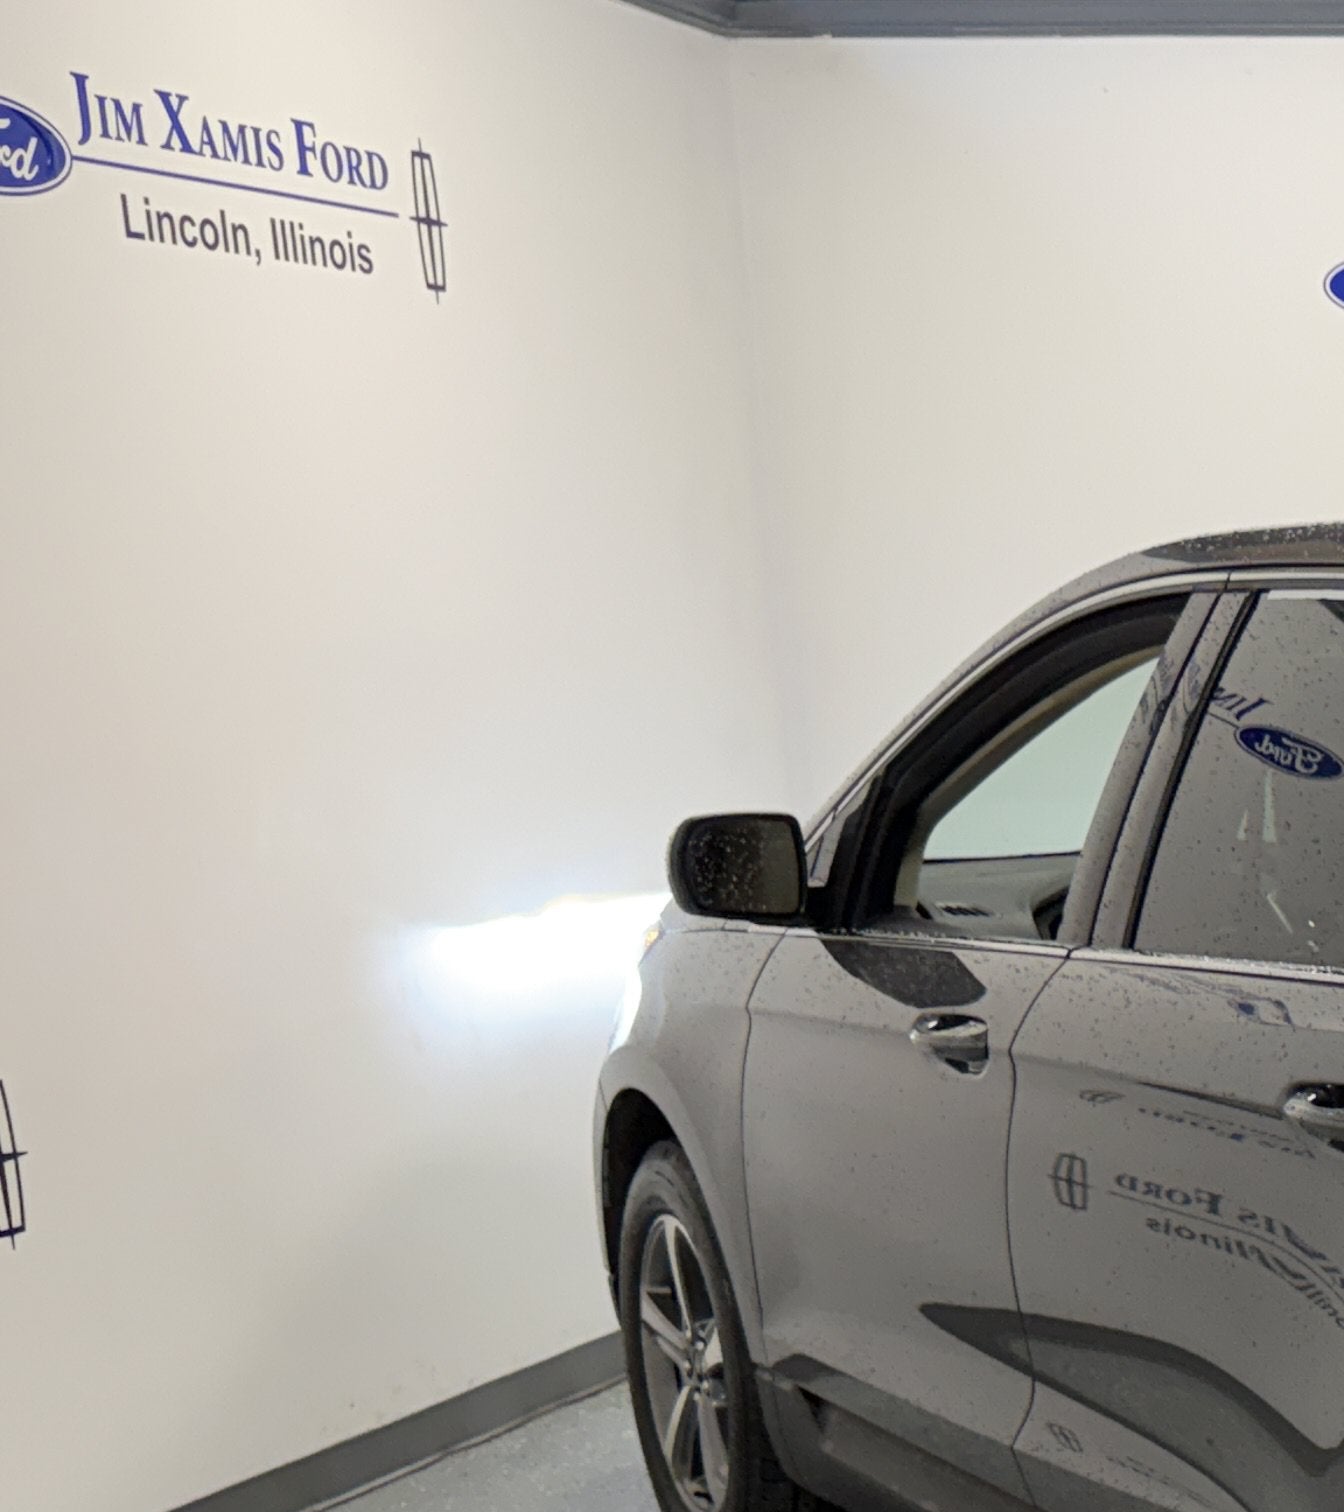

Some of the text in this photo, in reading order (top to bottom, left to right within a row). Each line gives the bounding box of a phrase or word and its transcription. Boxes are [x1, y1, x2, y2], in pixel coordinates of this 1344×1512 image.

[69, 71, 389, 190] JIM XAMIS FORD
[120, 193, 373, 274] Lincoln, Illinois
